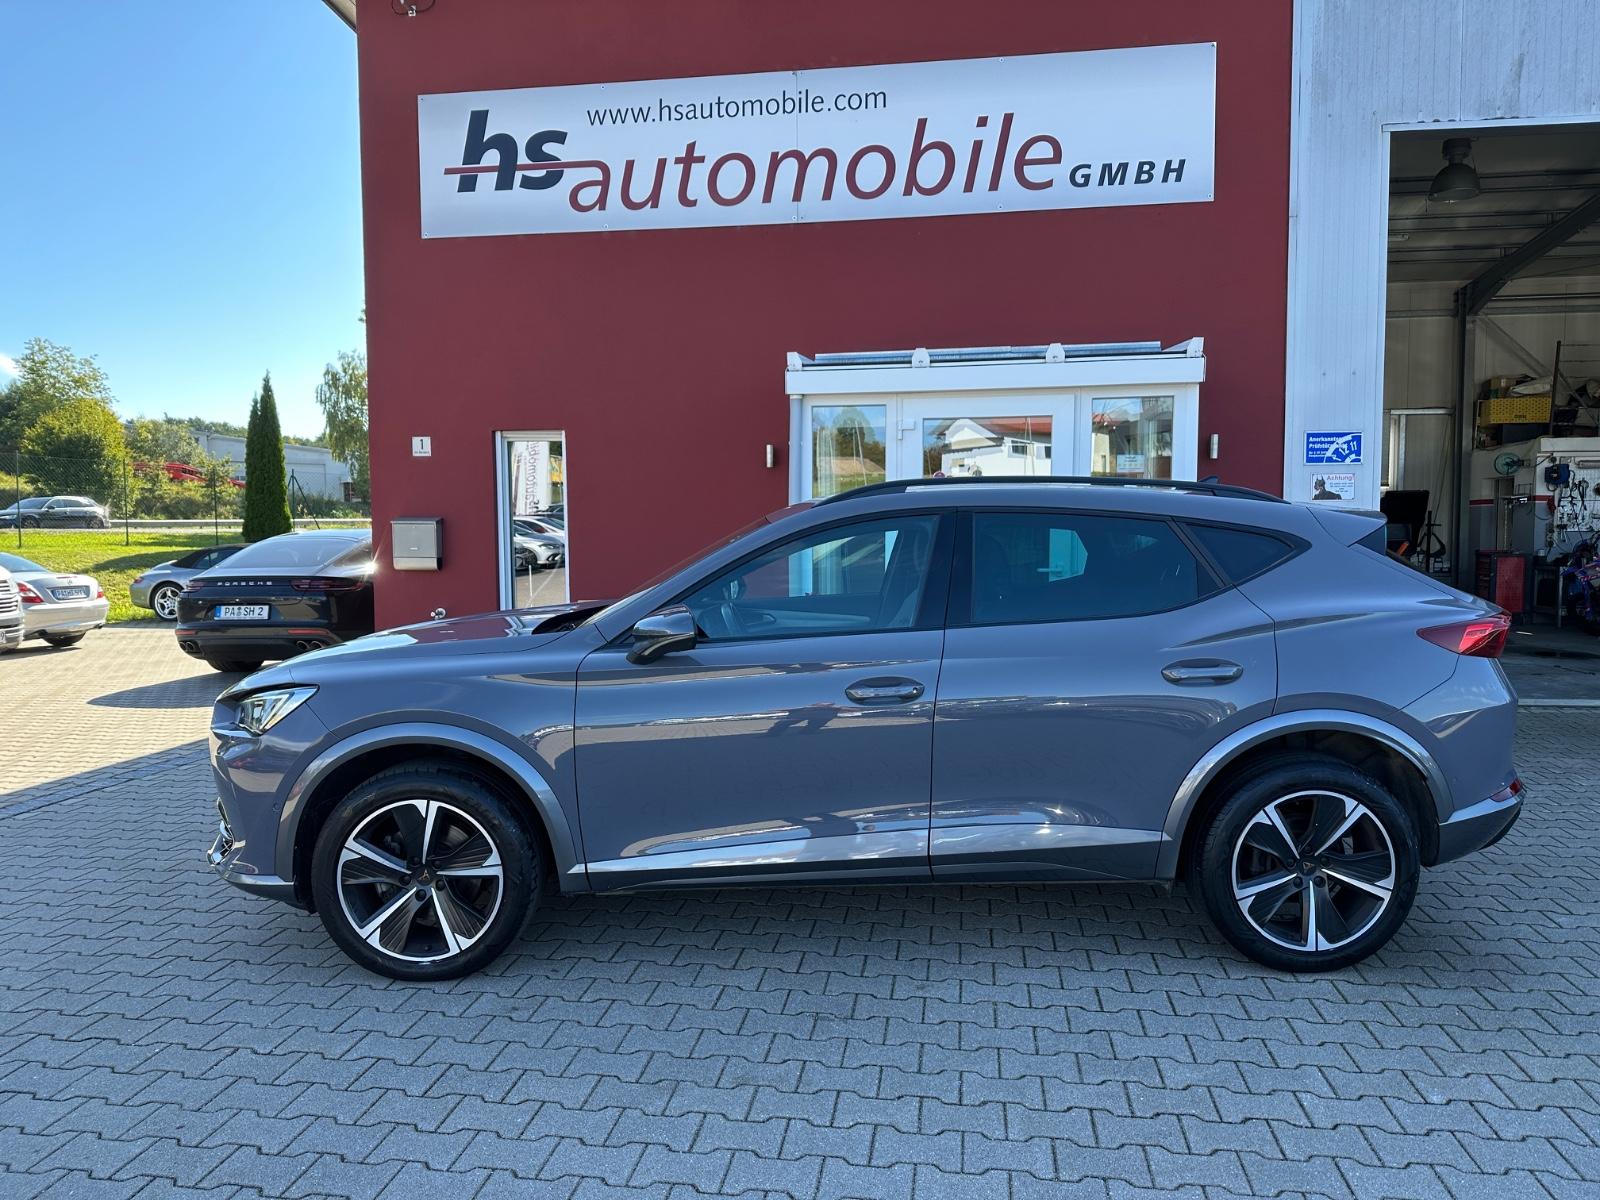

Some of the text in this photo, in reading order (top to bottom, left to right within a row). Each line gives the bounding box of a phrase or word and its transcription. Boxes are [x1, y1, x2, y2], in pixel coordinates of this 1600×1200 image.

[587, 89, 887, 126] www.hsautomobile.com
[457, 109, 1186, 213] hs automobile GMBH
[420, 438, 424, 450] 1
[224, 606, 263, 616] PA SH 2
